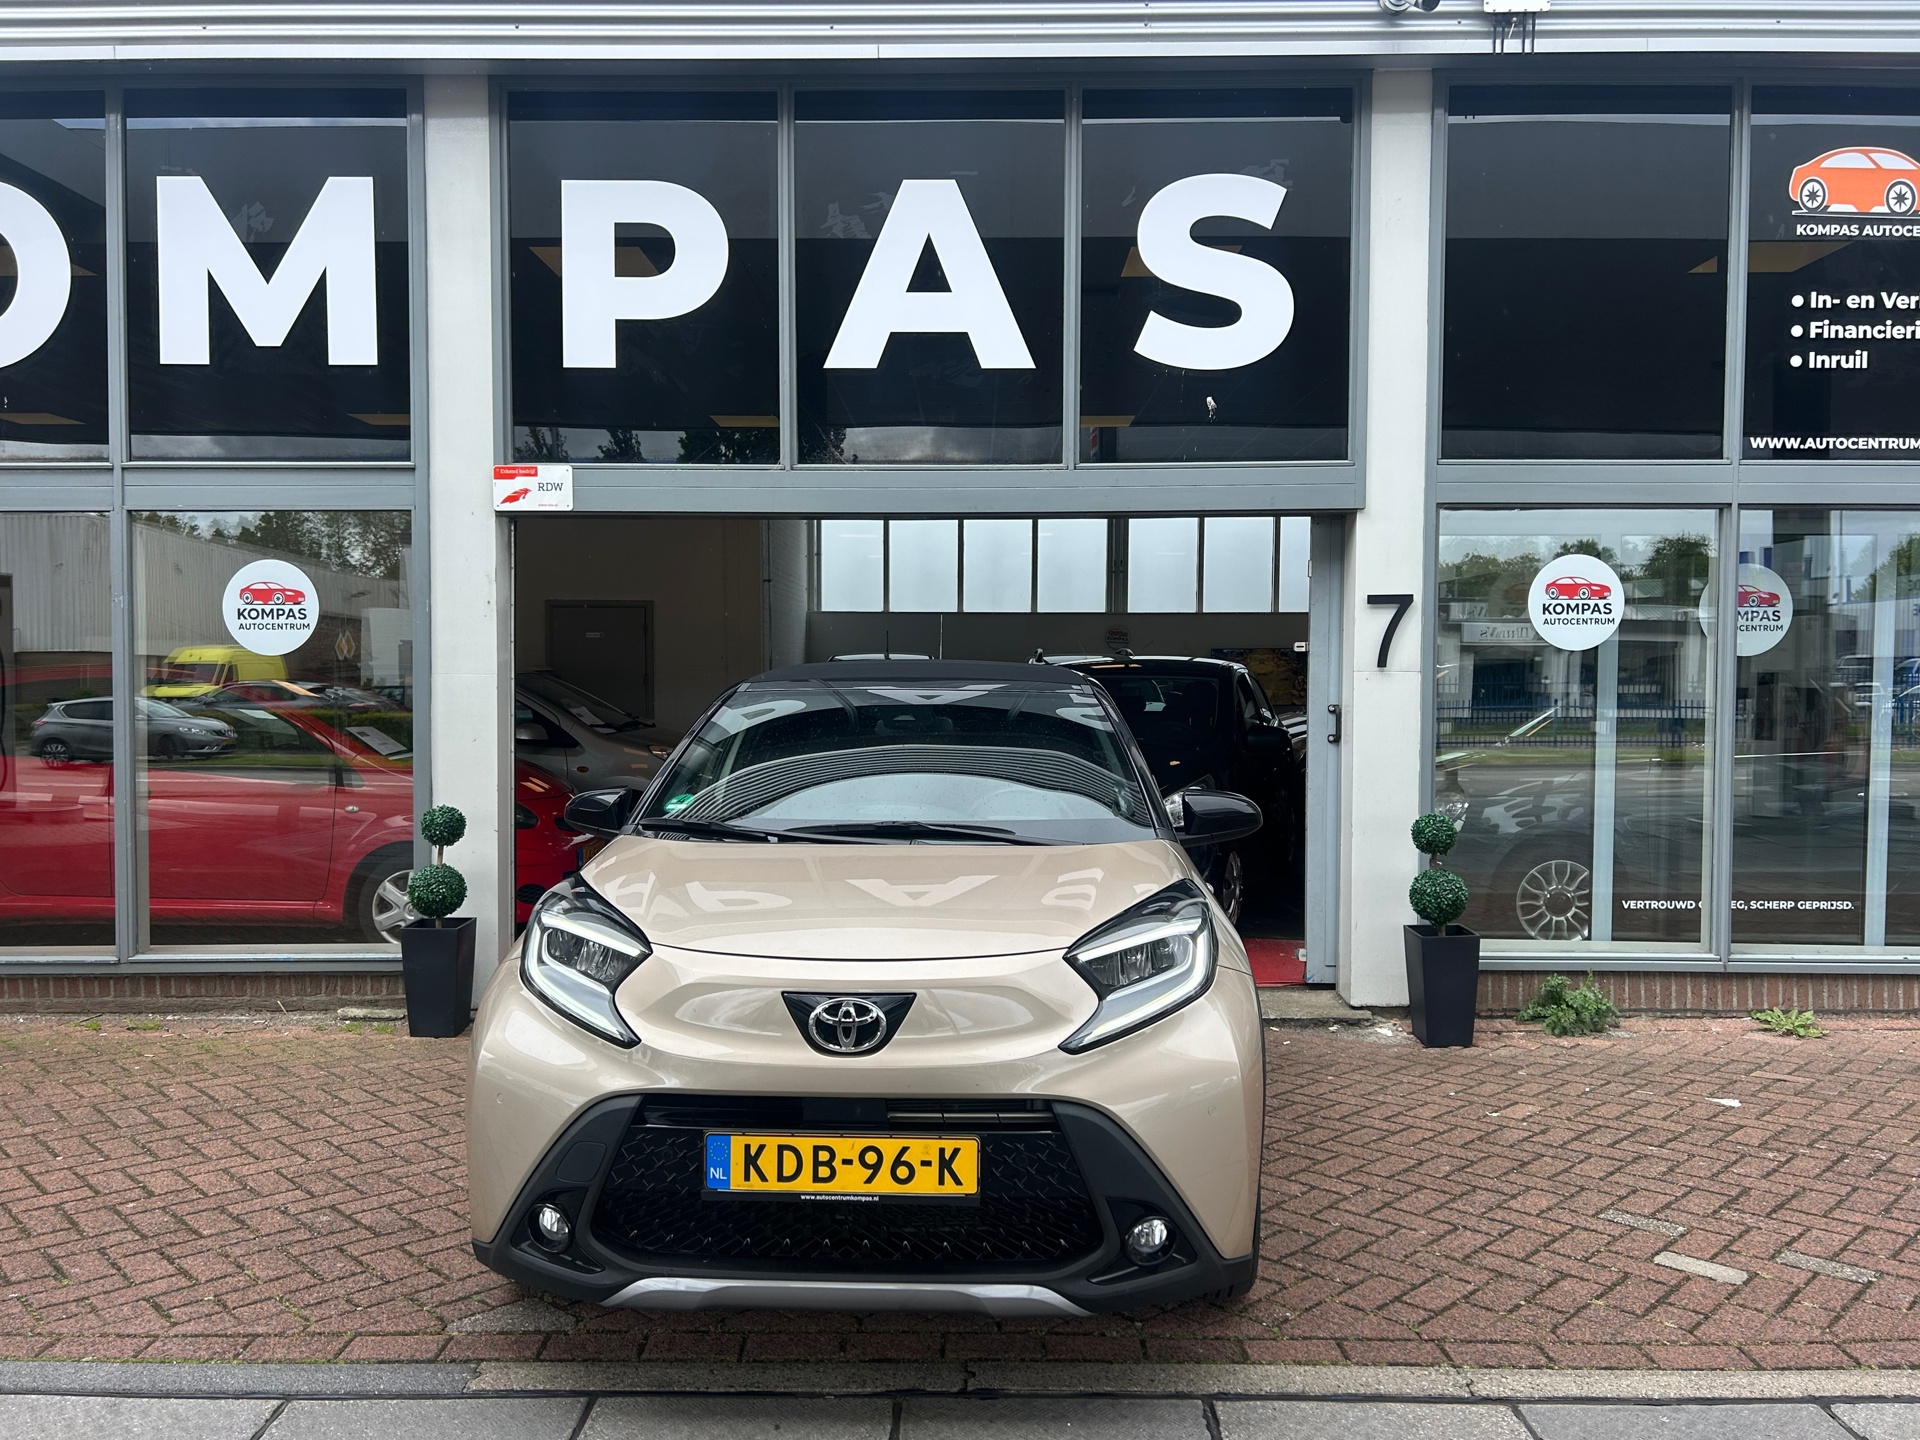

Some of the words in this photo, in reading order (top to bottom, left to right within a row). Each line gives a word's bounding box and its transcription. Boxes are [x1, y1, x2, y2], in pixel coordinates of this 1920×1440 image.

[1796, 224, 1859, 236] KOMPAS
[1810, 291, 1841, 309] In-
[1846, 294, 1875, 309] en
[1881, 291, 1920, 309] Ver
[1809, 319, 1920, 339] Financieri
[1808, 349, 1868, 369] Inruil
[1750, 437, 1920, 449] WWW.AUTOCENTRUM
[537, 482, 564, 492] RDW
[237, 608, 307, 621] KOMPAS
[1542, 602, 1613, 616] KOMPAS
[1543, 617, 1615, 626] AUTOCENTRUM
[1737, 610, 1781, 622] MPAS
[239, 623, 311, 631] AUTOCENTRUM
[1366, 593, 1415, 668] 7
[1738, 624, 1783, 632] CENTRUM
[1622, 900, 1695, 910] VERTROUWD
[1731, 900, 1748, 911] EG,
[1750, 900, 1795, 910] SCHERP
[1798, 901, 1855, 911] GEPRIJSD.
[743, 1143, 964, 1187] KDB-96-K
[709, 1167, 728, 1180] NL
[800, 1194, 880, 1203] www.autocentrumkompas.nl
